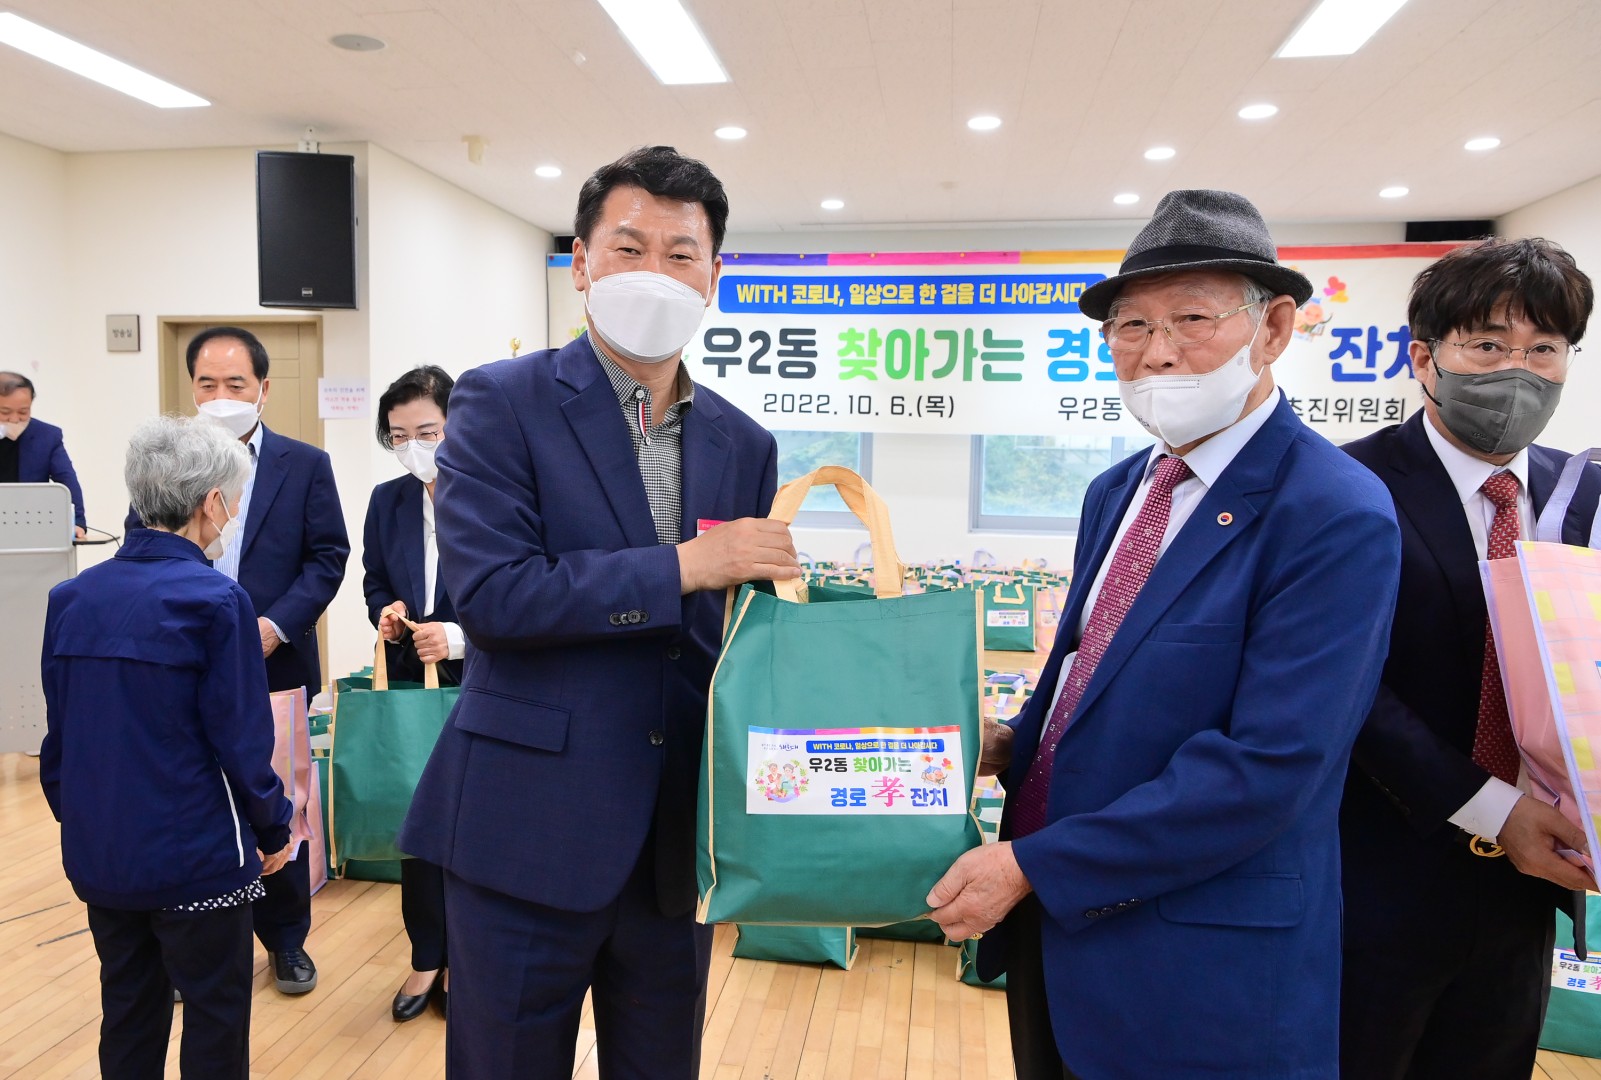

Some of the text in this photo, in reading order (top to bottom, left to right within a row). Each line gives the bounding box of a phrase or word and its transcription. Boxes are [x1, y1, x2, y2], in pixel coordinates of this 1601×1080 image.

[736, 284, 787, 304] WITH
[791, 283, 844, 307] 코로나,
[849, 283, 915, 305] 일상으로
[919, 283, 937, 305] 한
[941, 283, 974, 304] 걸음
[979, 283, 996, 304] 더
[702, 327, 818, 379] 우2동
[837, 327, 1025, 382] 찾아가는
[764, 393, 955, 418] 2022. 10. 6.(목)
[1058, 397, 1122, 421] 우2동
[809, 756, 912, 773] 우2동 찾아가는
[830, 776, 949, 807] 경로 孝 잔치
